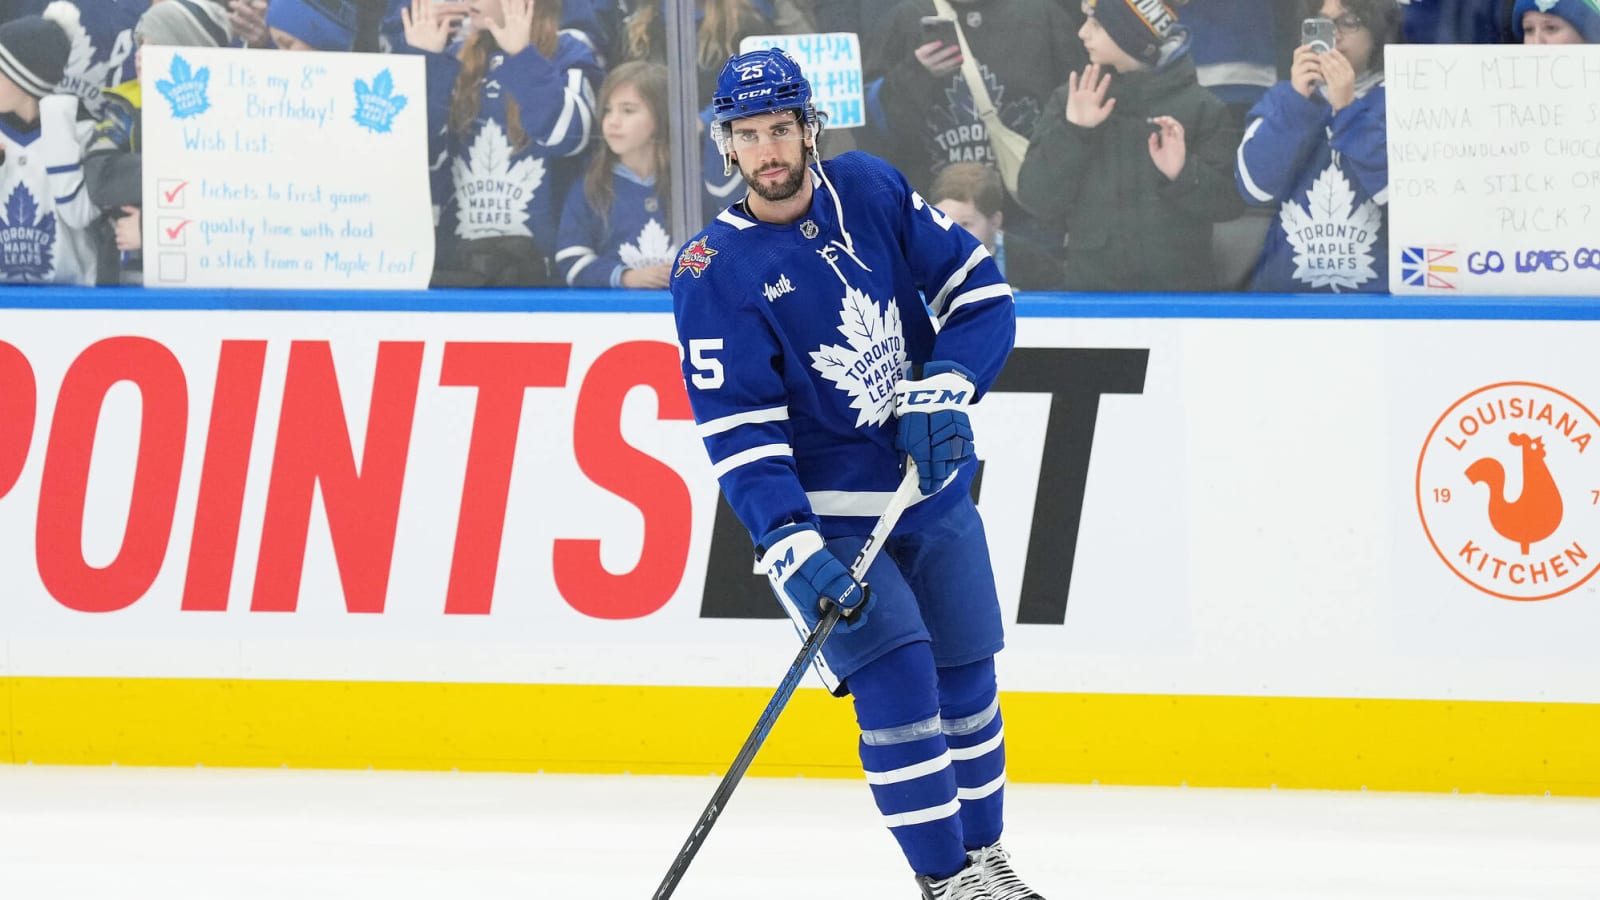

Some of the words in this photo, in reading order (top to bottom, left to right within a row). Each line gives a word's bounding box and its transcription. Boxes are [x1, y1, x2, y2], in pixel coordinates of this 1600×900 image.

[741, 64, 763, 81] 25
[1393, 58, 1459, 90] HEY
[267, 75, 289, 98] my
[738, 87, 772, 101] CCM
[246, 92, 335, 128] Birthday!
[1393, 106, 1473, 131] WANNA
[1489, 102, 1566, 128] TRADE
[183, 127, 227, 151] Wish
[948, 145, 997, 162] MAPL
[1391, 140, 1531, 163] NEWFOUNDLAND
[200, 178, 259, 200] tickets
[268, 182, 281, 201] to
[287, 182, 321, 203] first
[329, 192, 370, 212] game
[460, 179, 523, 201] TORONTO
[1393, 177, 1439, 198] FOR
[1453, 178, 1468, 194] A
[1484, 173, 1554, 196] STICK
[469, 198, 512, 210] MAPLE
[469, 212, 512, 225] LEAFS
[0, 226, 50, 246] ORONTO
[199, 217, 255, 246] quality
[263, 217, 293, 236] time
[300, 221, 334, 238] with
[340, 219, 374, 239] dad
[1295, 223, 1368, 244] TORONTO
[4, 242, 41, 254] MAPLE
[1307, 242, 1356, 255] MAPLE
[4, 254, 42, 266] LEAFS
[199, 255, 209, 269] a
[217, 249, 256, 270] stick
[263, 249, 299, 270] from
[303, 258, 313, 271] a
[324, 250, 369, 278] Maple
[378, 249, 416, 273] Leaf
[1307, 257, 1357, 270] LEAFS
[1467, 250, 1505, 275] GO
[761, 273, 796, 303] Milk
[845, 335, 901, 382] TORONTO
[863, 352, 901, 390] MAPLE
[868, 368, 904, 404] LEAFS
[1445, 397, 1593, 454] LOUISIANA
[1433, 488, 1451, 504] 19
[1458, 540, 1589, 584] KITCHEN
